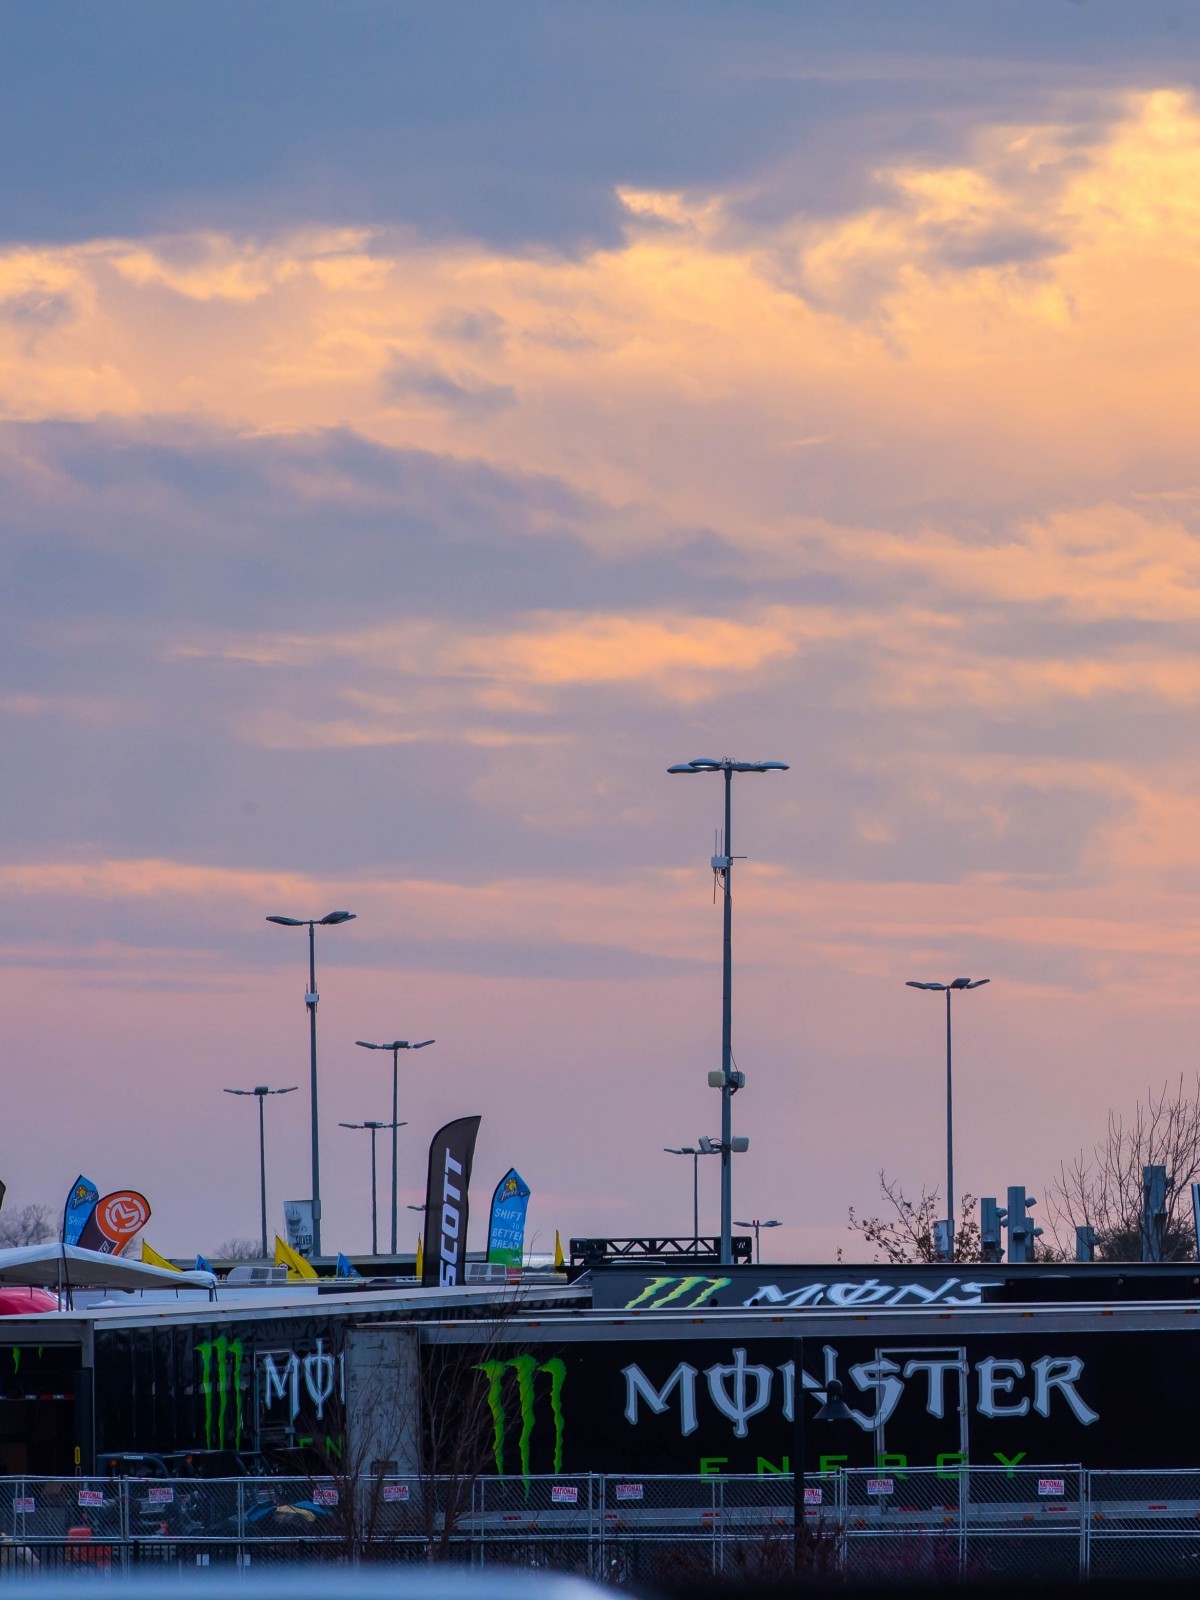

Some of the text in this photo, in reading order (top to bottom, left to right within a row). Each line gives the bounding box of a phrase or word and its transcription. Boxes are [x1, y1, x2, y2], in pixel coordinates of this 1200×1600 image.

[439, 1148, 462, 1288] SCOTT
[495, 1208, 523, 1222] SHIFT
[295, 1234, 313, 1246] SILVER
[491, 1239, 520, 1251] BREAD
[620, 1345, 1100, 1439] MONSTER
[700, 1451, 1027, 1484] ENERGY
[617, 1484, 641, 1493] NATIONAL
[868, 1480, 893, 1488] NATIONAL
[1039, 1480, 1063, 1488] NATIONAL
[79, 1491, 101, 1500] NATIONAL
[150, 1488, 172, 1496] NATIONAL
[553, 1487, 577, 1496] NATIONAL
